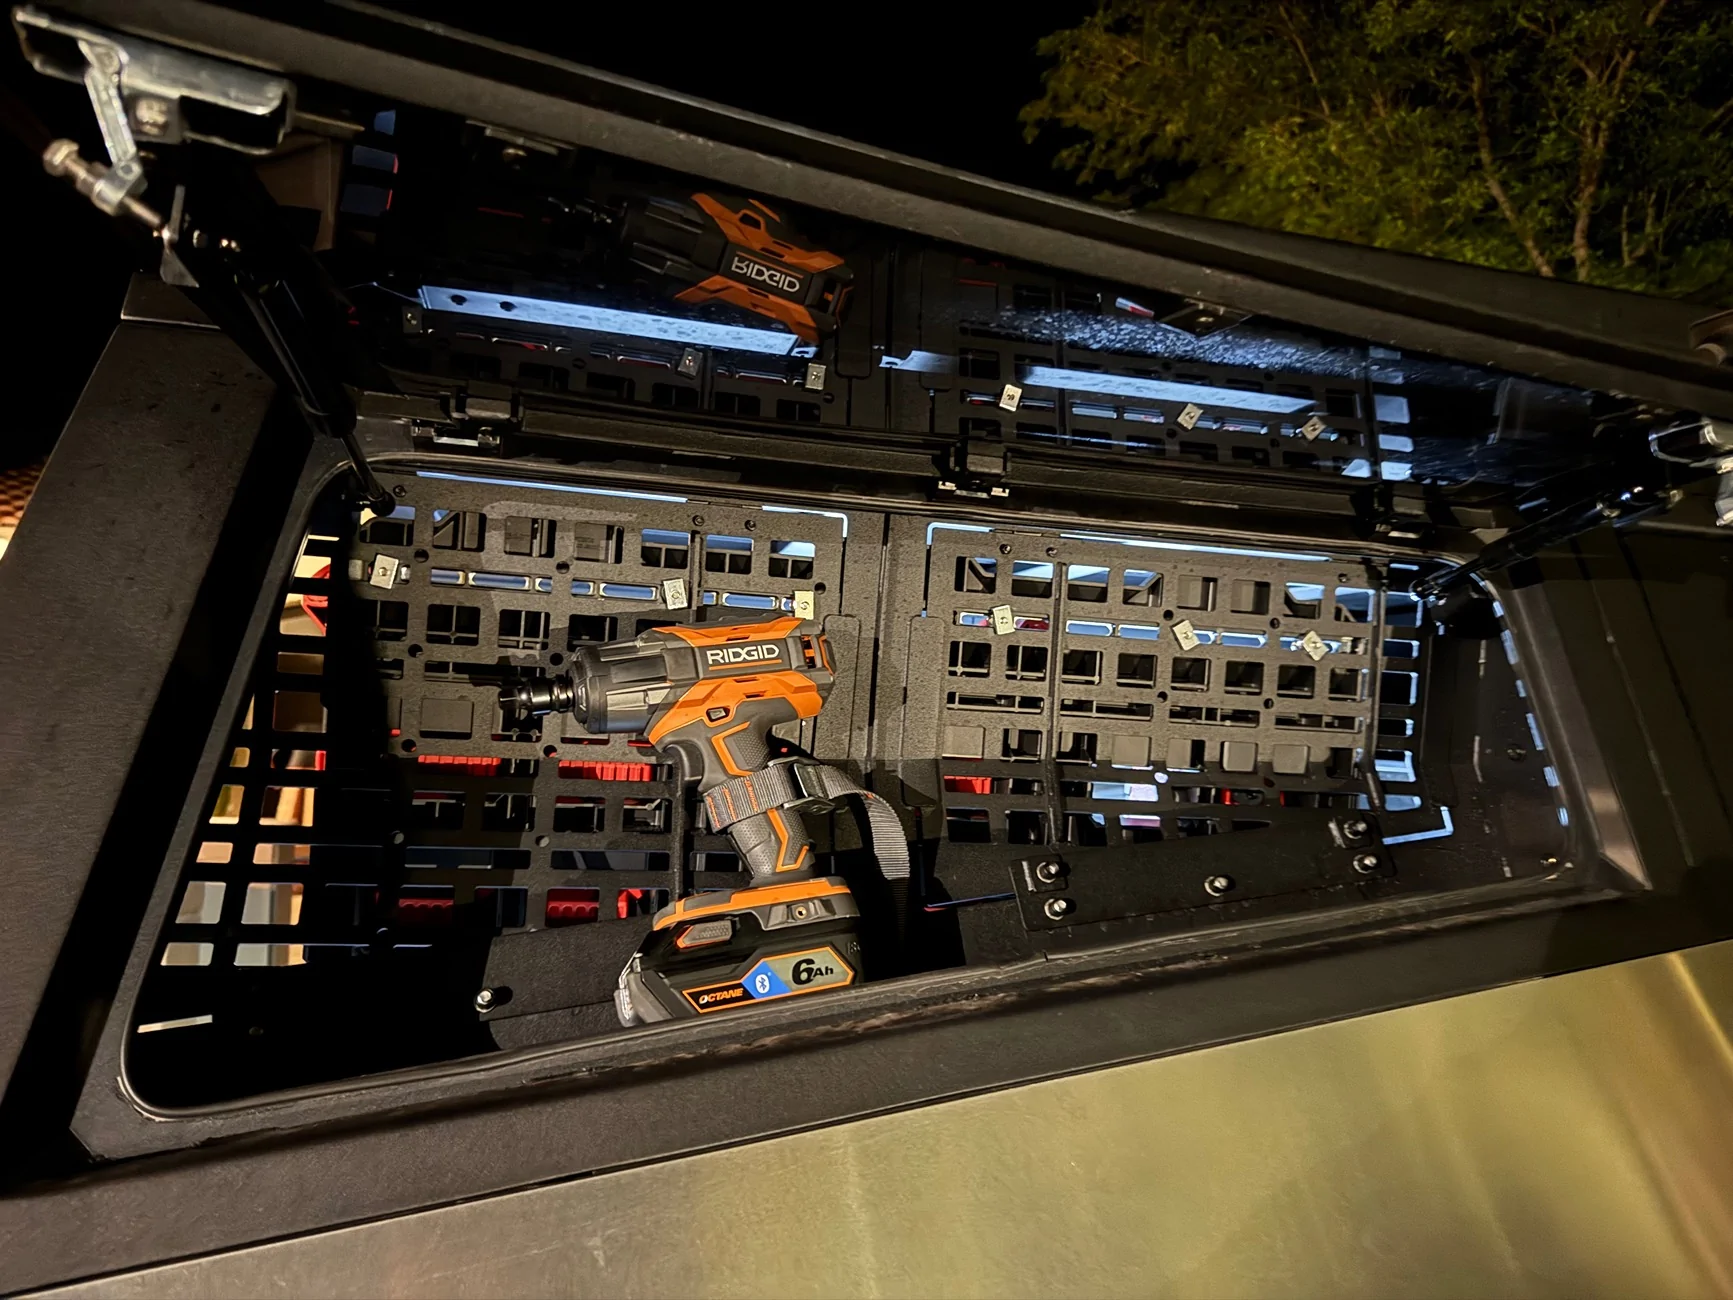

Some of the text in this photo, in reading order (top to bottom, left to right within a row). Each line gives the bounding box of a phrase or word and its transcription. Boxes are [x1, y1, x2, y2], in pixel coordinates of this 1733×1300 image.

[706, 644, 780, 664] RIDGID
[791, 958, 834, 986] 6Ah
[698, 988, 744, 1004] OCTANE
